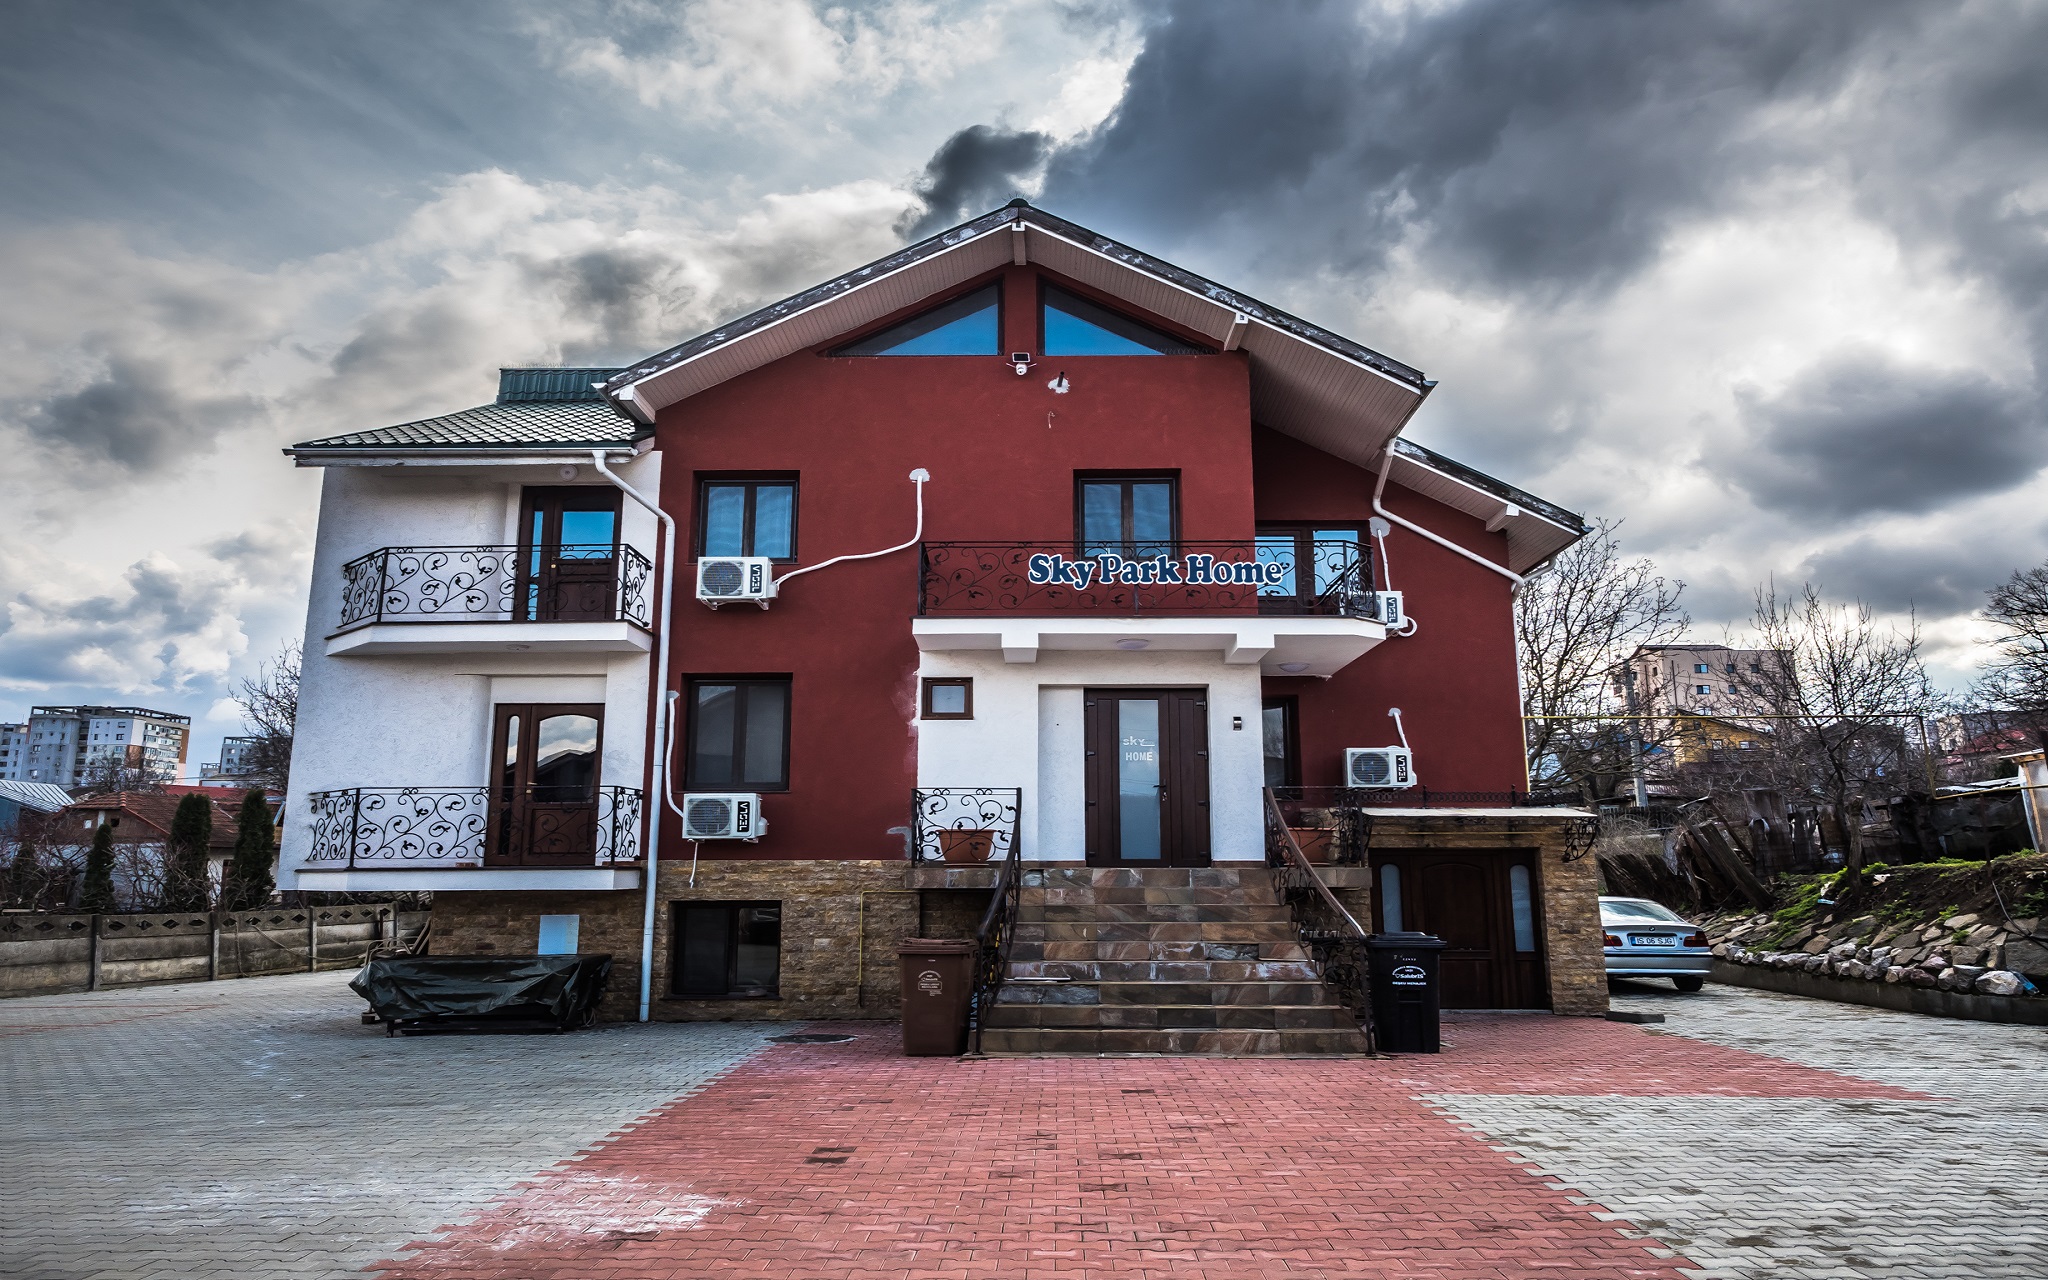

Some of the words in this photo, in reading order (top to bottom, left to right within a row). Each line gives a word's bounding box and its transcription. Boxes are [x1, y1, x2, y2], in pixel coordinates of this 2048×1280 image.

[752, 565, 761, 592] TESLA
[1028, 553, 1096, 590] Sky
[1098, 553, 1183, 585] Park
[1185, 553, 1283, 585] Home
[1388, 598, 1396, 622] TESLA
[1125, 751, 1153, 761] HOME
[1398, 756, 1406, 781] TESLA
[739, 802, 749, 831] TESLA
[1636, 937, 1645, 945] IS
